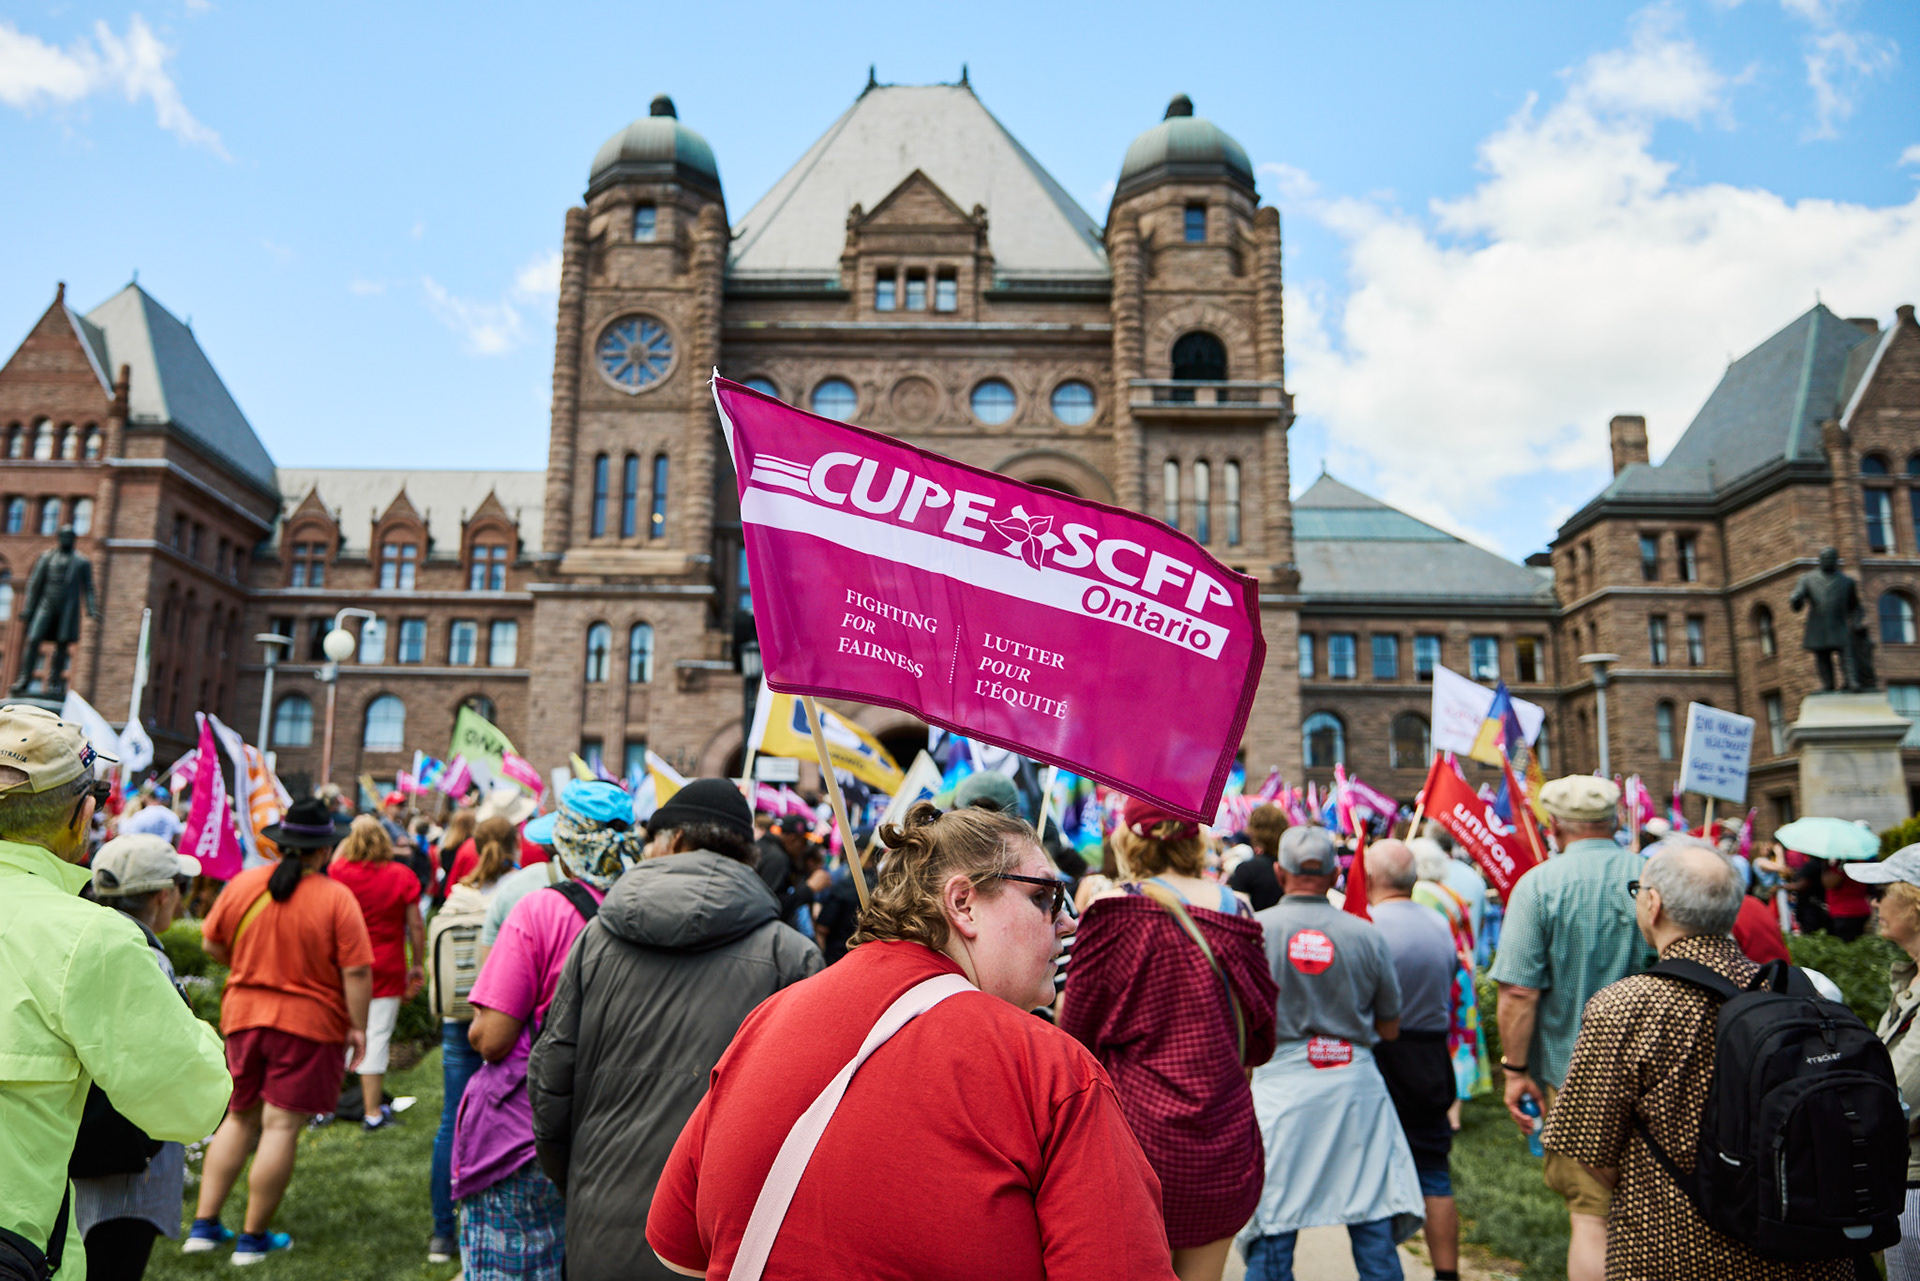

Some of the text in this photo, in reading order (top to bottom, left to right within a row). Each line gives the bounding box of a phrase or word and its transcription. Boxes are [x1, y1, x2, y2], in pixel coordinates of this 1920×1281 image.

[808, 451, 1234, 614] CUPE SCFP
[841, 612, 876, 635] FOR
[846, 588, 938, 634] FIGHTING
[1081, 585, 1212, 651] Ontario
[838, 636, 924, 679] FAIRNESS
[978, 656, 1031, 684] POUR
[982, 633, 1065, 669] LUTTER
[974, 679, 1068, 720] L’ÉQUITÉ
[0, 749, 27, 763] STRALIA
